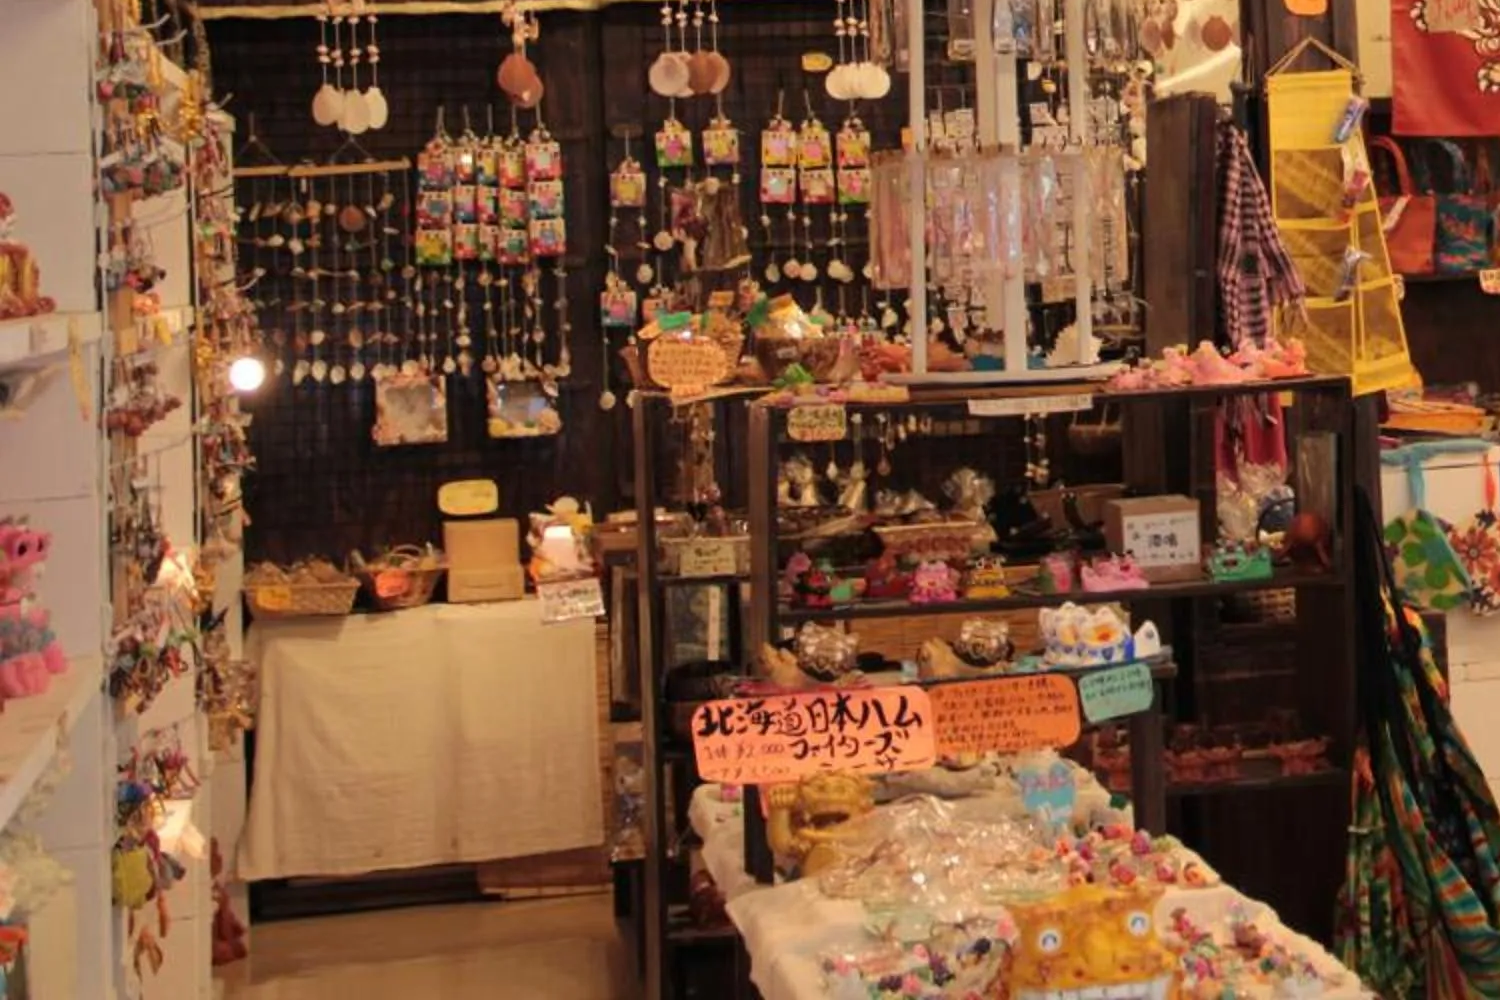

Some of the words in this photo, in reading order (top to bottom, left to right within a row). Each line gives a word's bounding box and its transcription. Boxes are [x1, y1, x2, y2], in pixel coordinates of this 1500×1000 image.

[697, 692, 922, 737] 北海道日本ハム
[789, 729, 910, 761] ファイターズ
